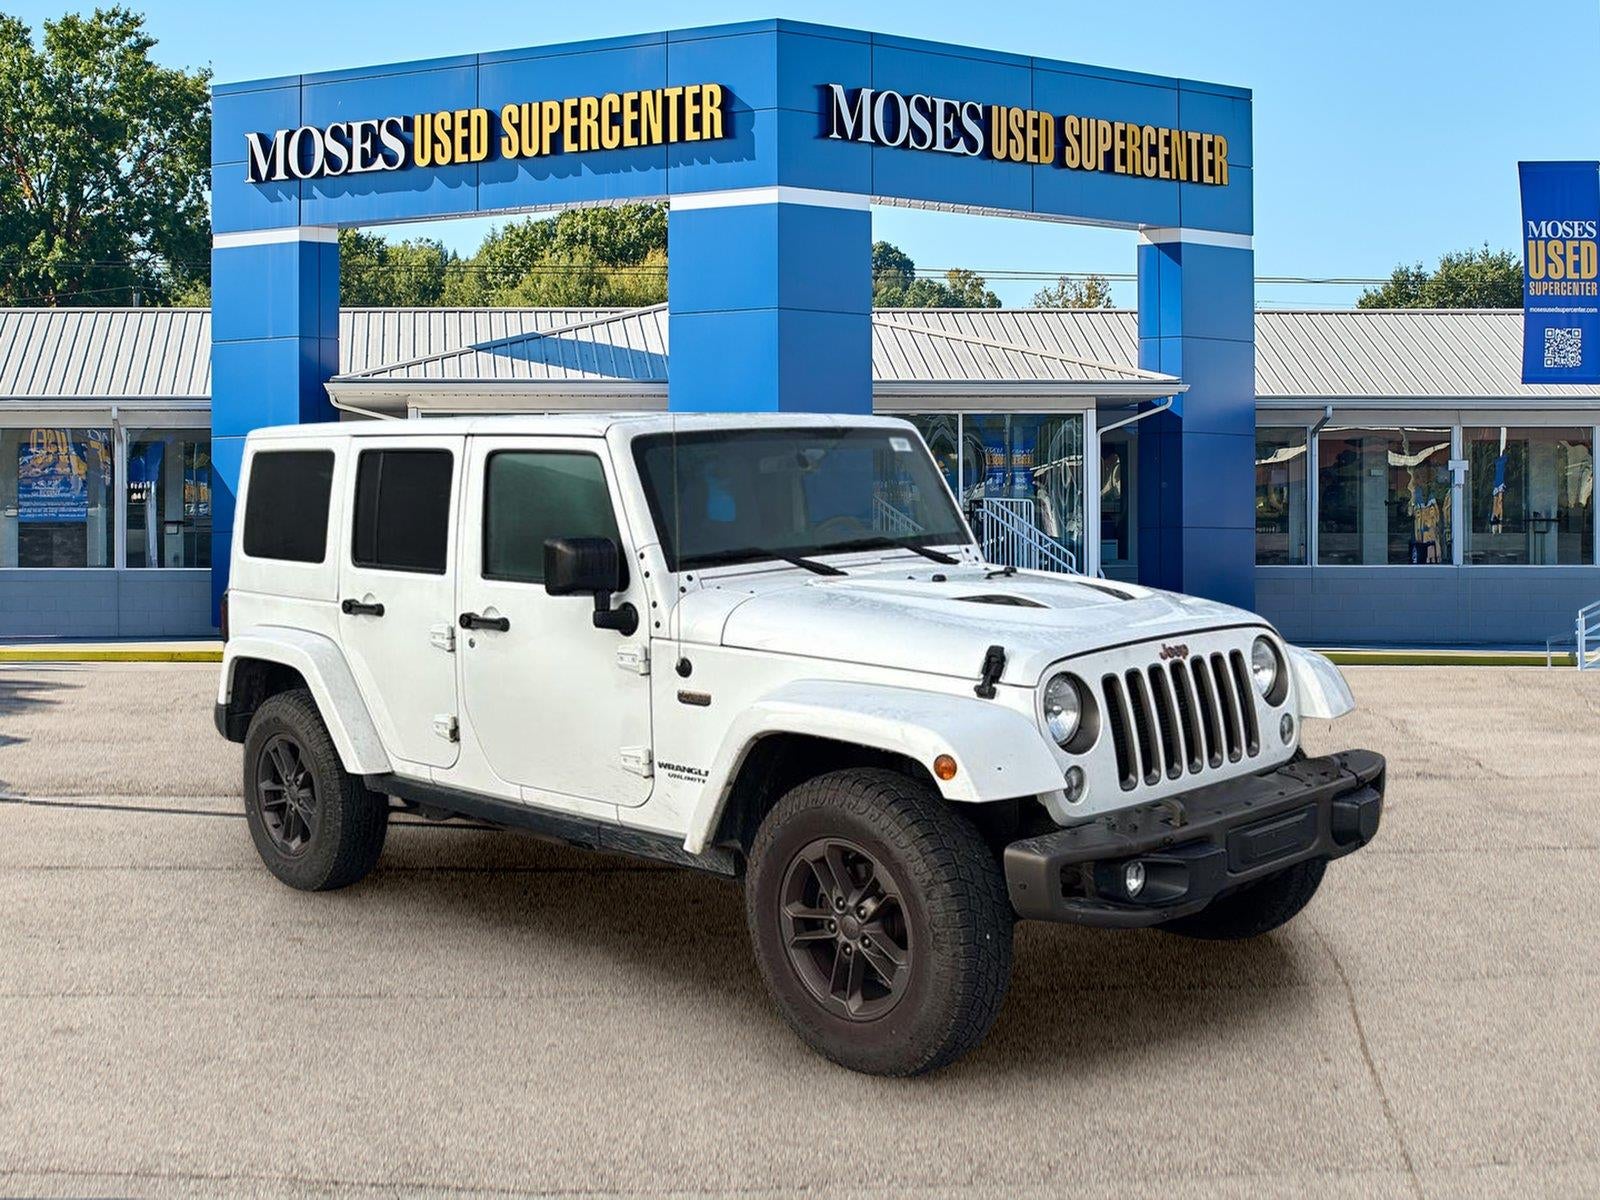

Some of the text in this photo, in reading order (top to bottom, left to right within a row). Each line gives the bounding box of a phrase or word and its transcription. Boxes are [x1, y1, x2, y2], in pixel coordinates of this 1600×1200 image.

[244, 83, 724, 184] MOSES USED SUPERCENTER
[828, 83, 1229, 186] MOSES USED SUPERCENTER
[1527, 220, 1597, 239] MOSES
[1527, 240, 1598, 280] USED
[1529, 281, 1598, 297] SUPERCENTER
[1159, 643, 1189, 660] Jeep
